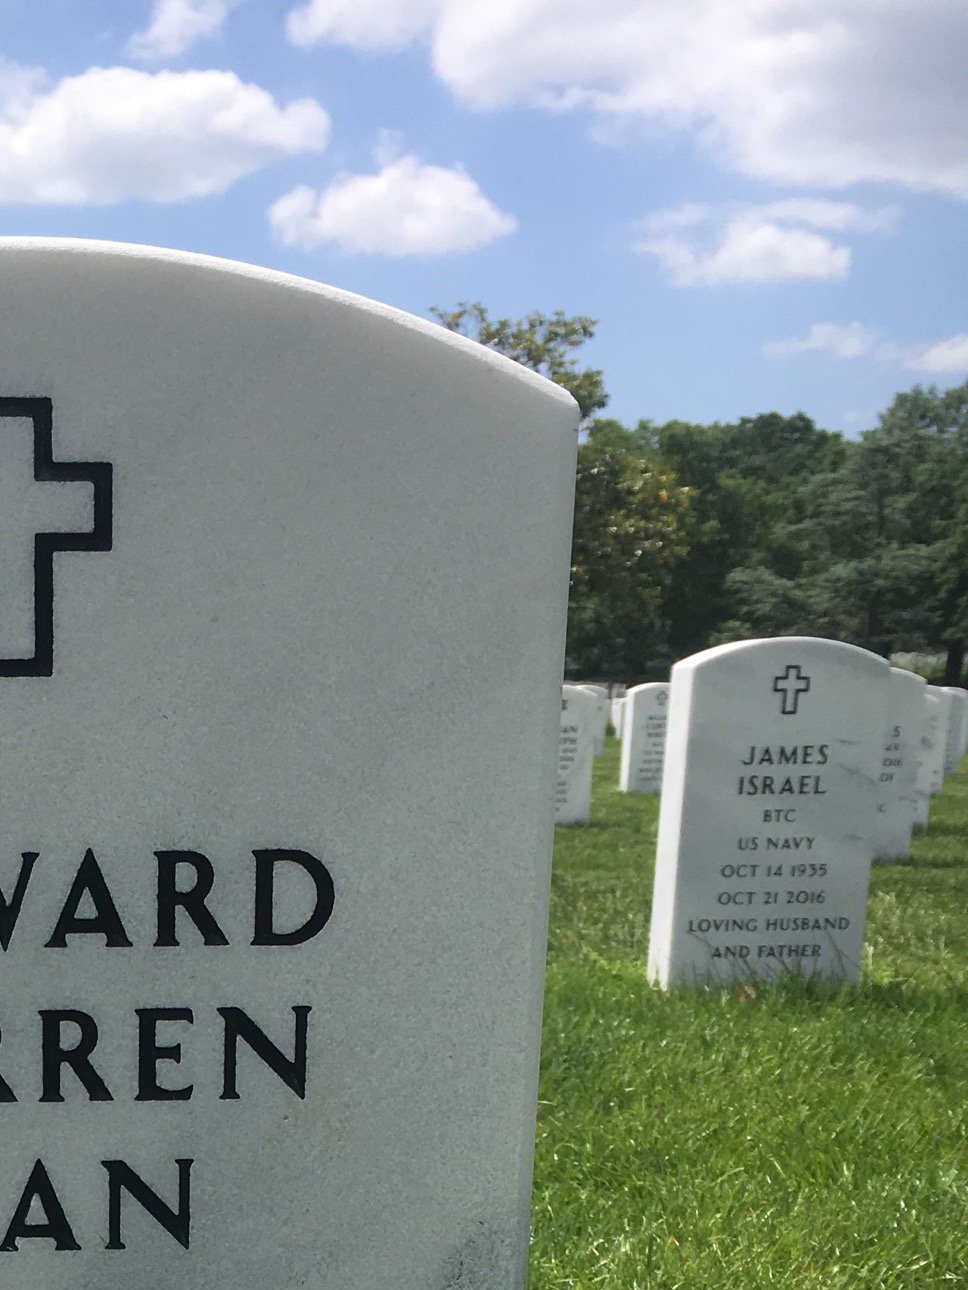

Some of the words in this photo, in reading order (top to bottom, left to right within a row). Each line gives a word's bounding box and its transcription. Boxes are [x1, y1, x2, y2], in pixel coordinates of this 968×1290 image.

[742, 744, 829, 766] JAMES
[738, 775, 827, 795] ISRAEL
[762, 809, 797, 823] BTC
[738, 837, 759, 850] US
[766, 836, 816, 850] NAVY
[721, 865, 760, 878] OCT
[766, 864, 783, 877] 14
[791, 863, 828, 877] 1935
[717, 892, 756, 905] OCT
[763, 891, 778, 905] 21
[786, 891, 826, 904] 2016
[687, 918, 758, 932] LOVING
[766, 917, 850, 931] HUSBAND
[711, 945, 750, 959] AND
[758, 944, 822, 958] FATHER
